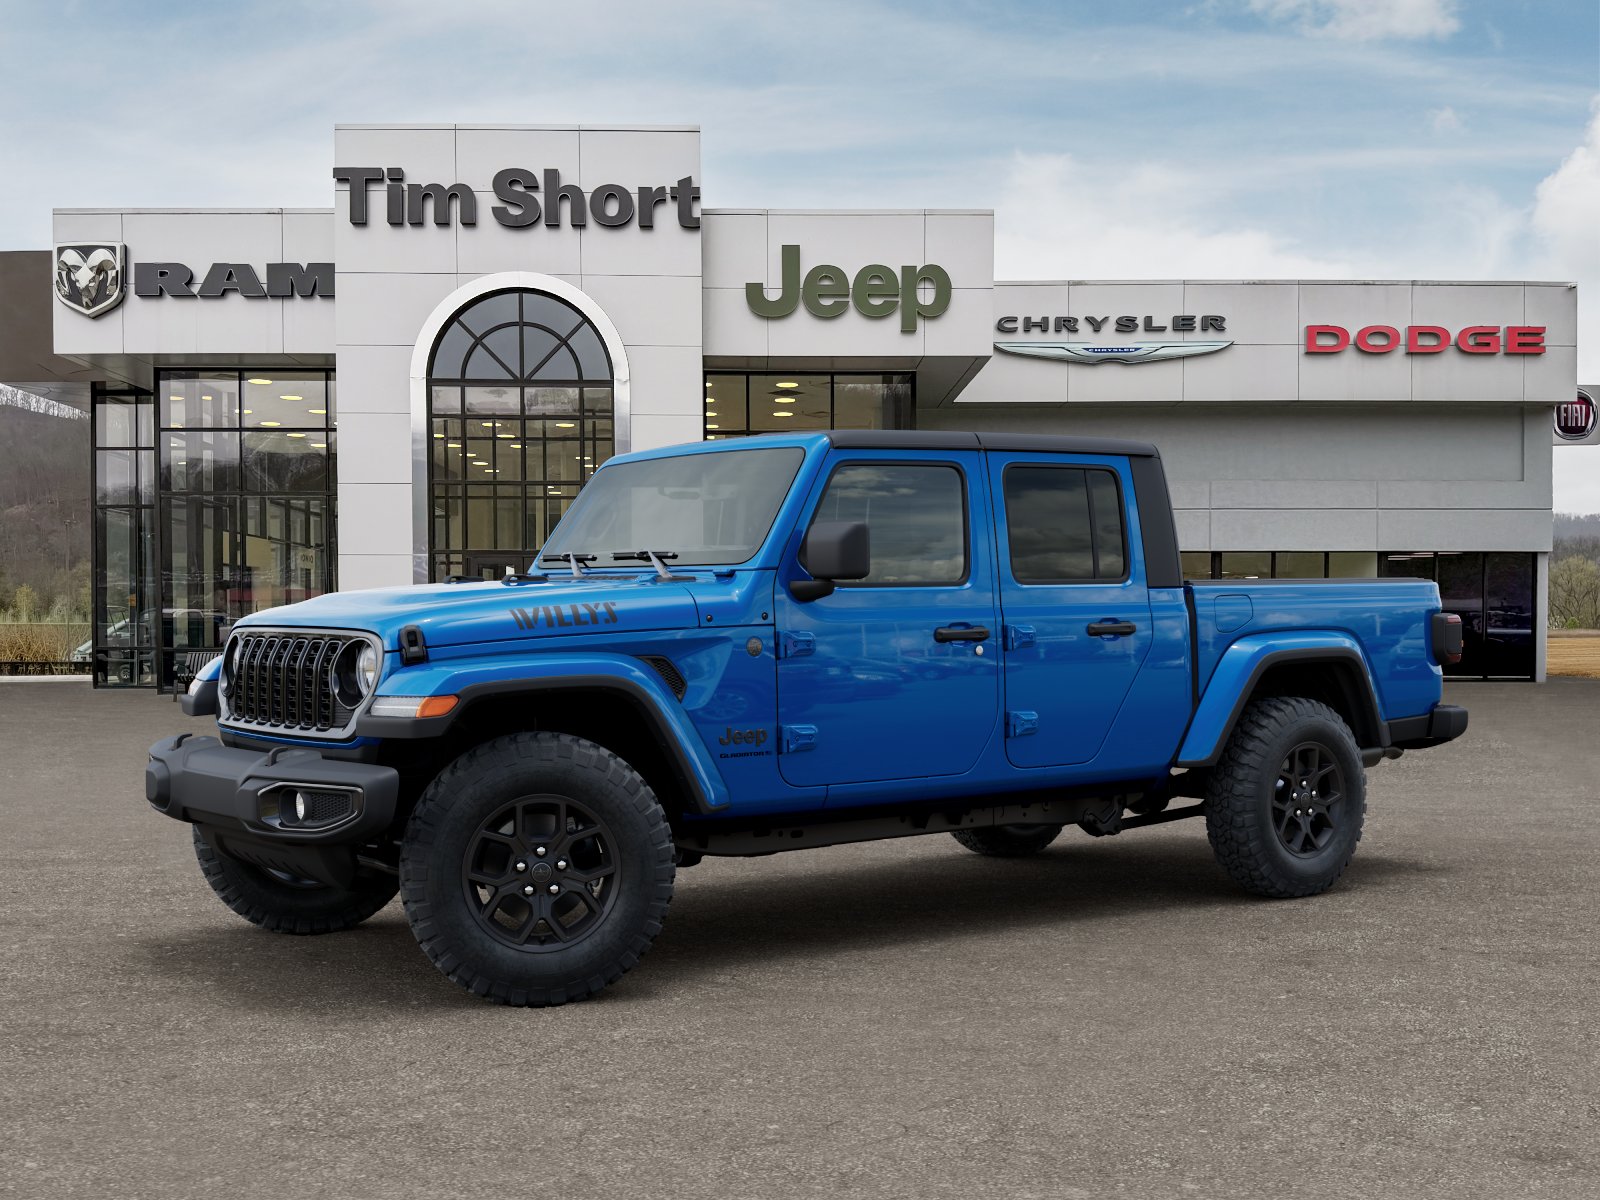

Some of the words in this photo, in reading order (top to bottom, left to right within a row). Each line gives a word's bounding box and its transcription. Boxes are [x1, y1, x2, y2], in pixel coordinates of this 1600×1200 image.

[332, 167, 476, 227] Tim
[491, 167, 701, 230] Short
[134, 262, 335, 298] RAM
[745, 244, 953, 333] Jeep
[996, 315, 1227, 333] CHRYSLER
[1304, 324, 1547, 355] DODGE
[1560, 404, 1586, 427] FIAT
[509, 601, 618, 630] WILLYS
[719, 726, 768, 747] Jeep
[719, 751, 765, 759] GLADIATOR
